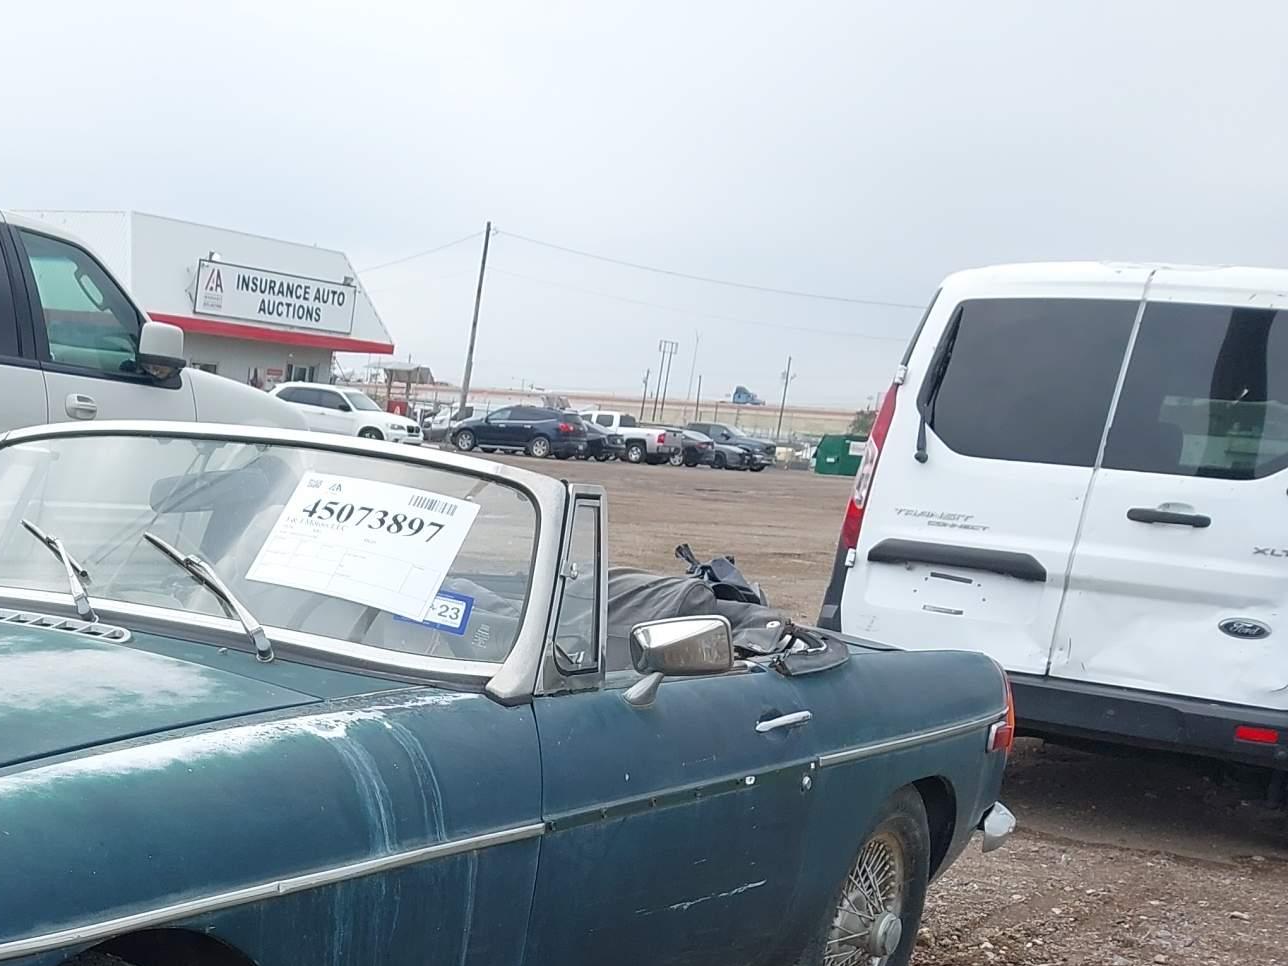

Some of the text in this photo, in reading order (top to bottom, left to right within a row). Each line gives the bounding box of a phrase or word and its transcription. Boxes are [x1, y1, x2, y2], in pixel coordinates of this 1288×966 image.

[236, 273, 346, 307] INSURANCE AUTO
[258, 299, 322, 323] AUCTIONS
[302, 499, 445, 543] 45073897
[894, 507, 974, 521] TRANSIT
[927, 521, 991, 531] CONNECT
[437, 604, 461, 620] 23
